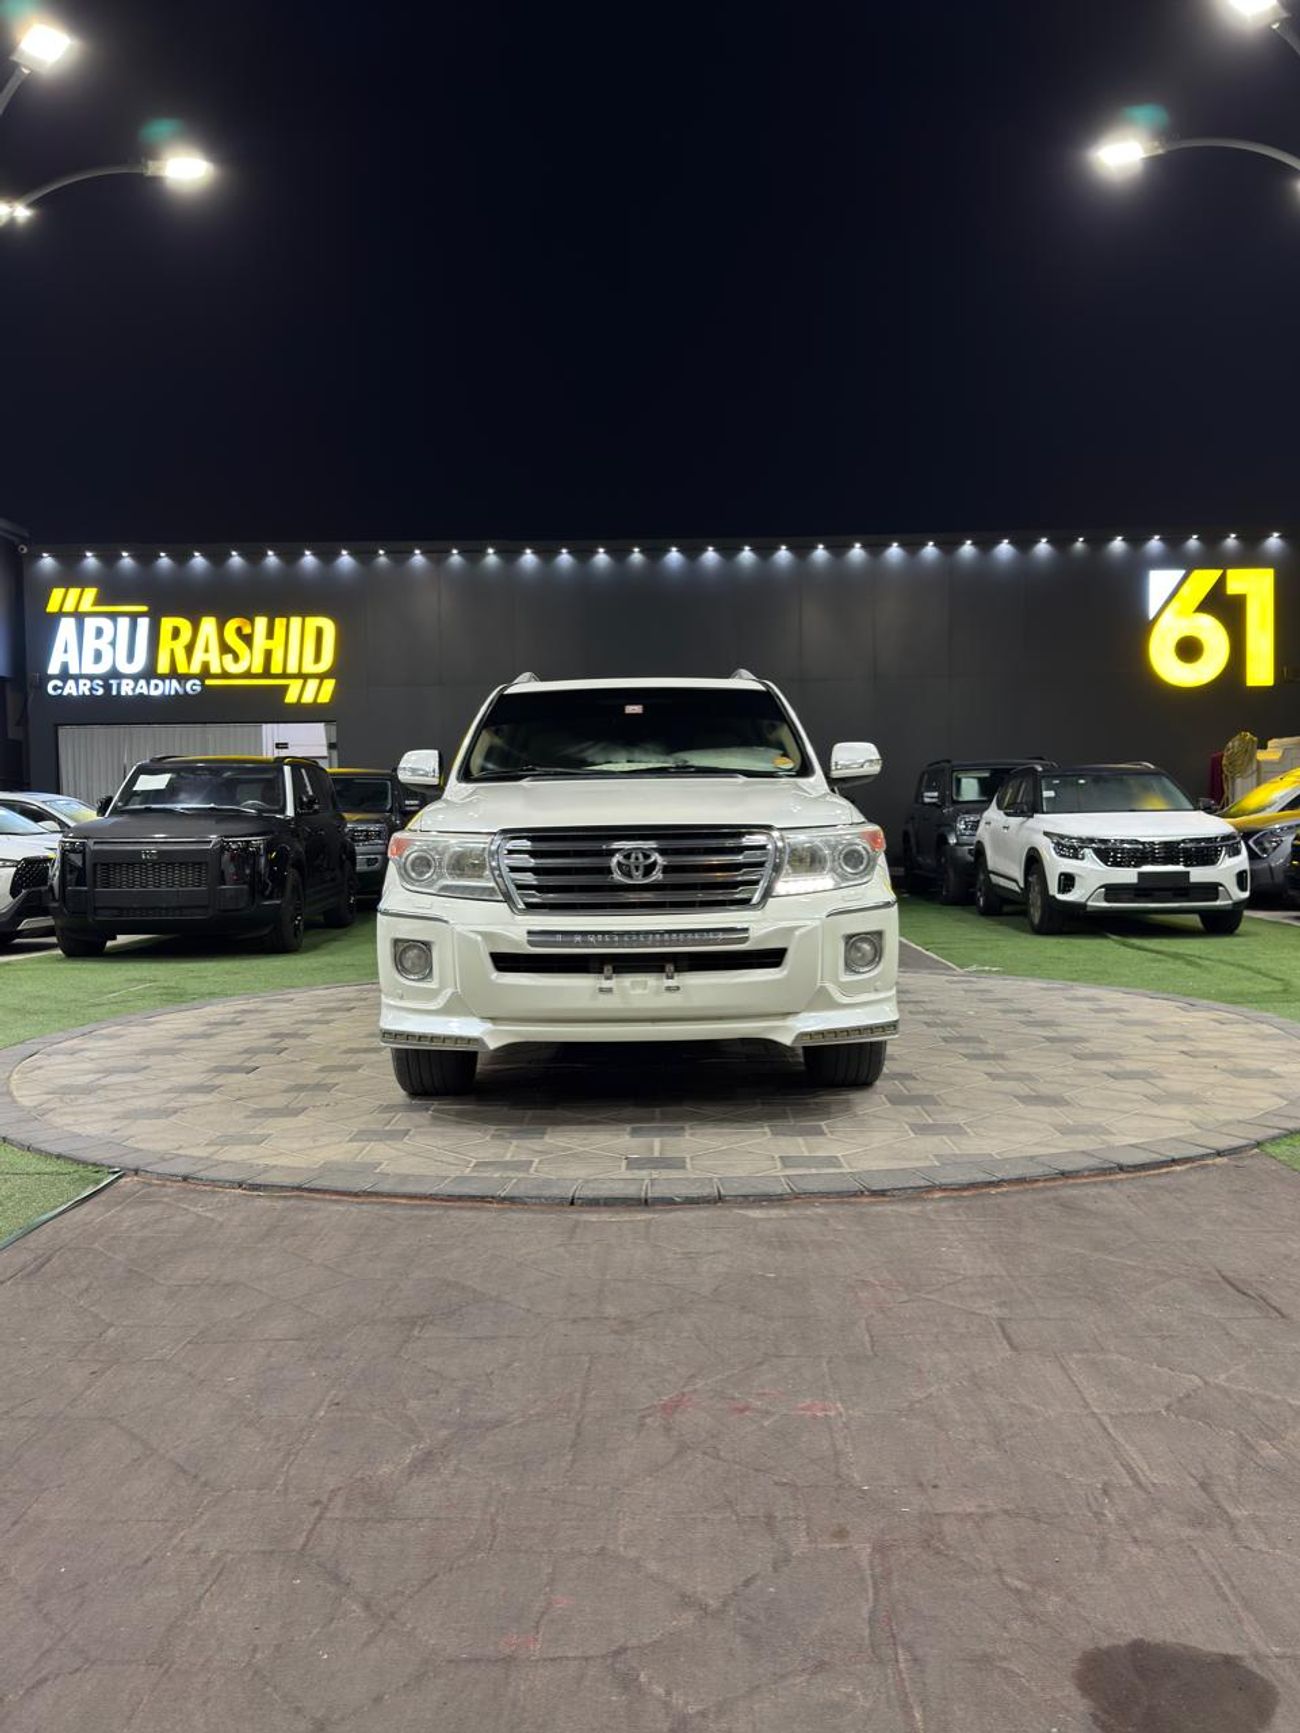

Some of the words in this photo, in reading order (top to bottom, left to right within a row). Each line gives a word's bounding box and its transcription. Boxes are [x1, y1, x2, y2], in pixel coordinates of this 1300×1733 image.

[47, 617, 150, 675] ABU
[156, 617, 336, 675] RASHID
[1148, 568, 1275, 688] 61
[47, 679, 104, 696] CARS
[109, 679, 202, 696] TRADING
